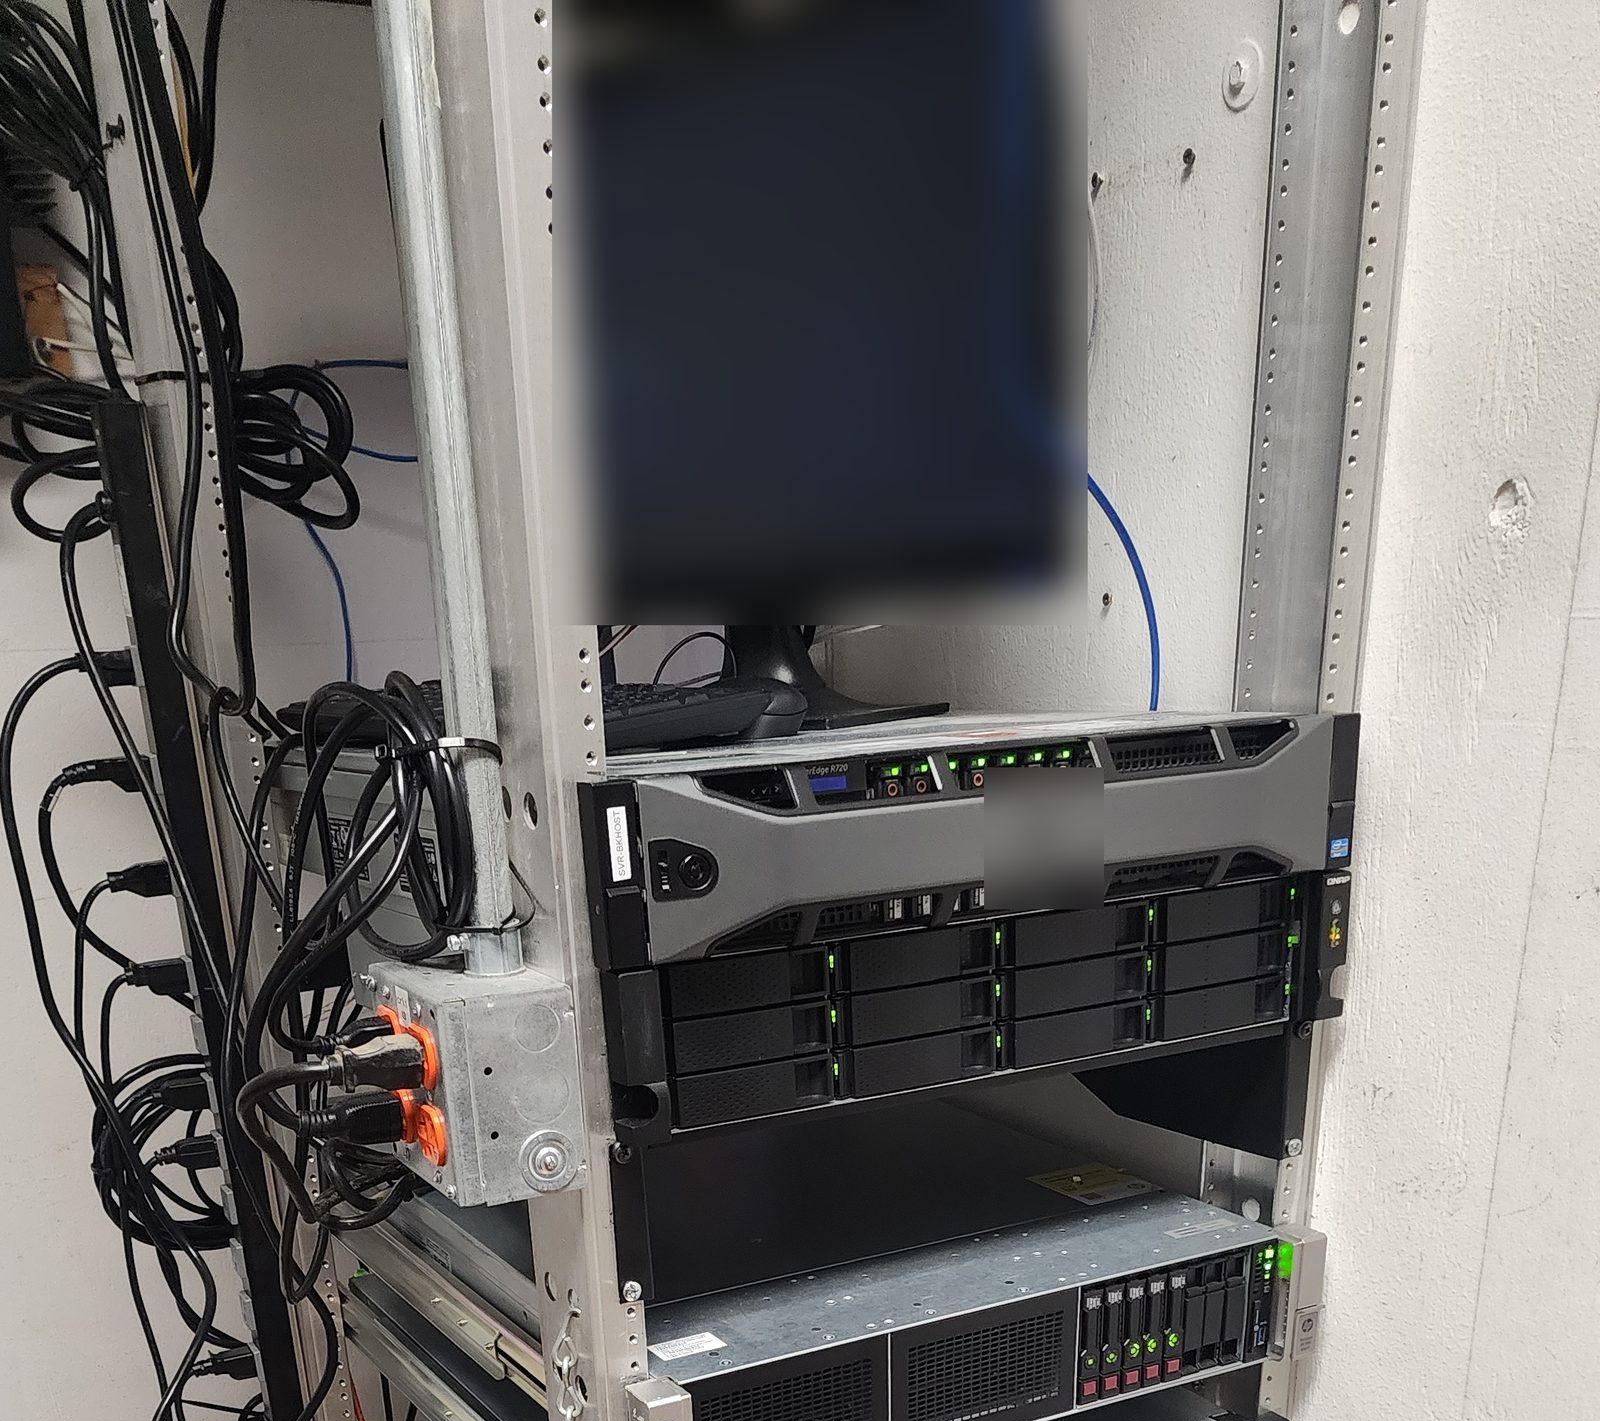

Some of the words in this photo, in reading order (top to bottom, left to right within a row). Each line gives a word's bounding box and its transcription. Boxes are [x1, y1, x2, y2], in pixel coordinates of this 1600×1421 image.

[830, 763, 848, 774] R720
[613, 810, 626, 876] SVR-BKHOST
[1326, 875, 1351, 887] QNAP
